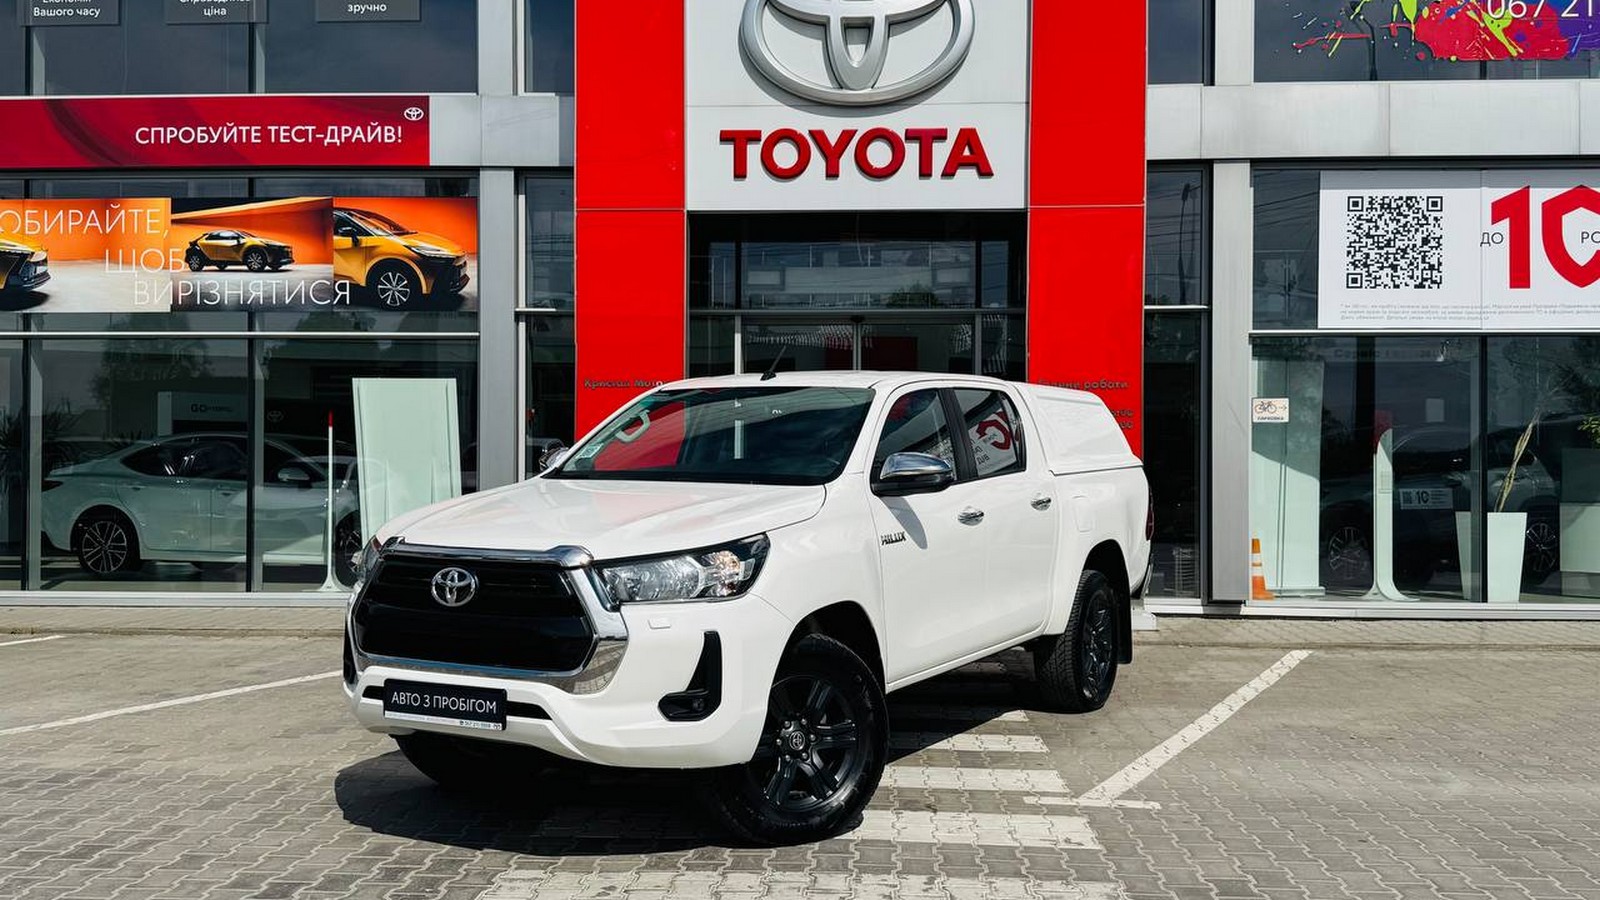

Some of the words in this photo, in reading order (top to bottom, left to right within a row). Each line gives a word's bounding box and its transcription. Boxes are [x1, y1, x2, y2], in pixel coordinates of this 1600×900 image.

[33, 7, 74, 17] Вашого
[76, 8, 101, 18] часу
[203, 6, 227, 17] ціна
[347, 4, 387, 14] зручно
[135, 122, 261, 145] СПРОБУЙТЕ
[267, 122, 403, 146] ТЕСТ-ДРАЙВ!
[719, 127, 994, 182] TOYOTA
[1480, 232, 1504, 247] ДО
[105, 249, 184, 277] ЩОБ
[134, 279, 350, 306] ВИРІЗНЯТИСЯ
[391, 692, 421, 706] АВТО
[423, 695, 431, 708] З
[433, 695, 497, 714] ПРОБІГОМ
